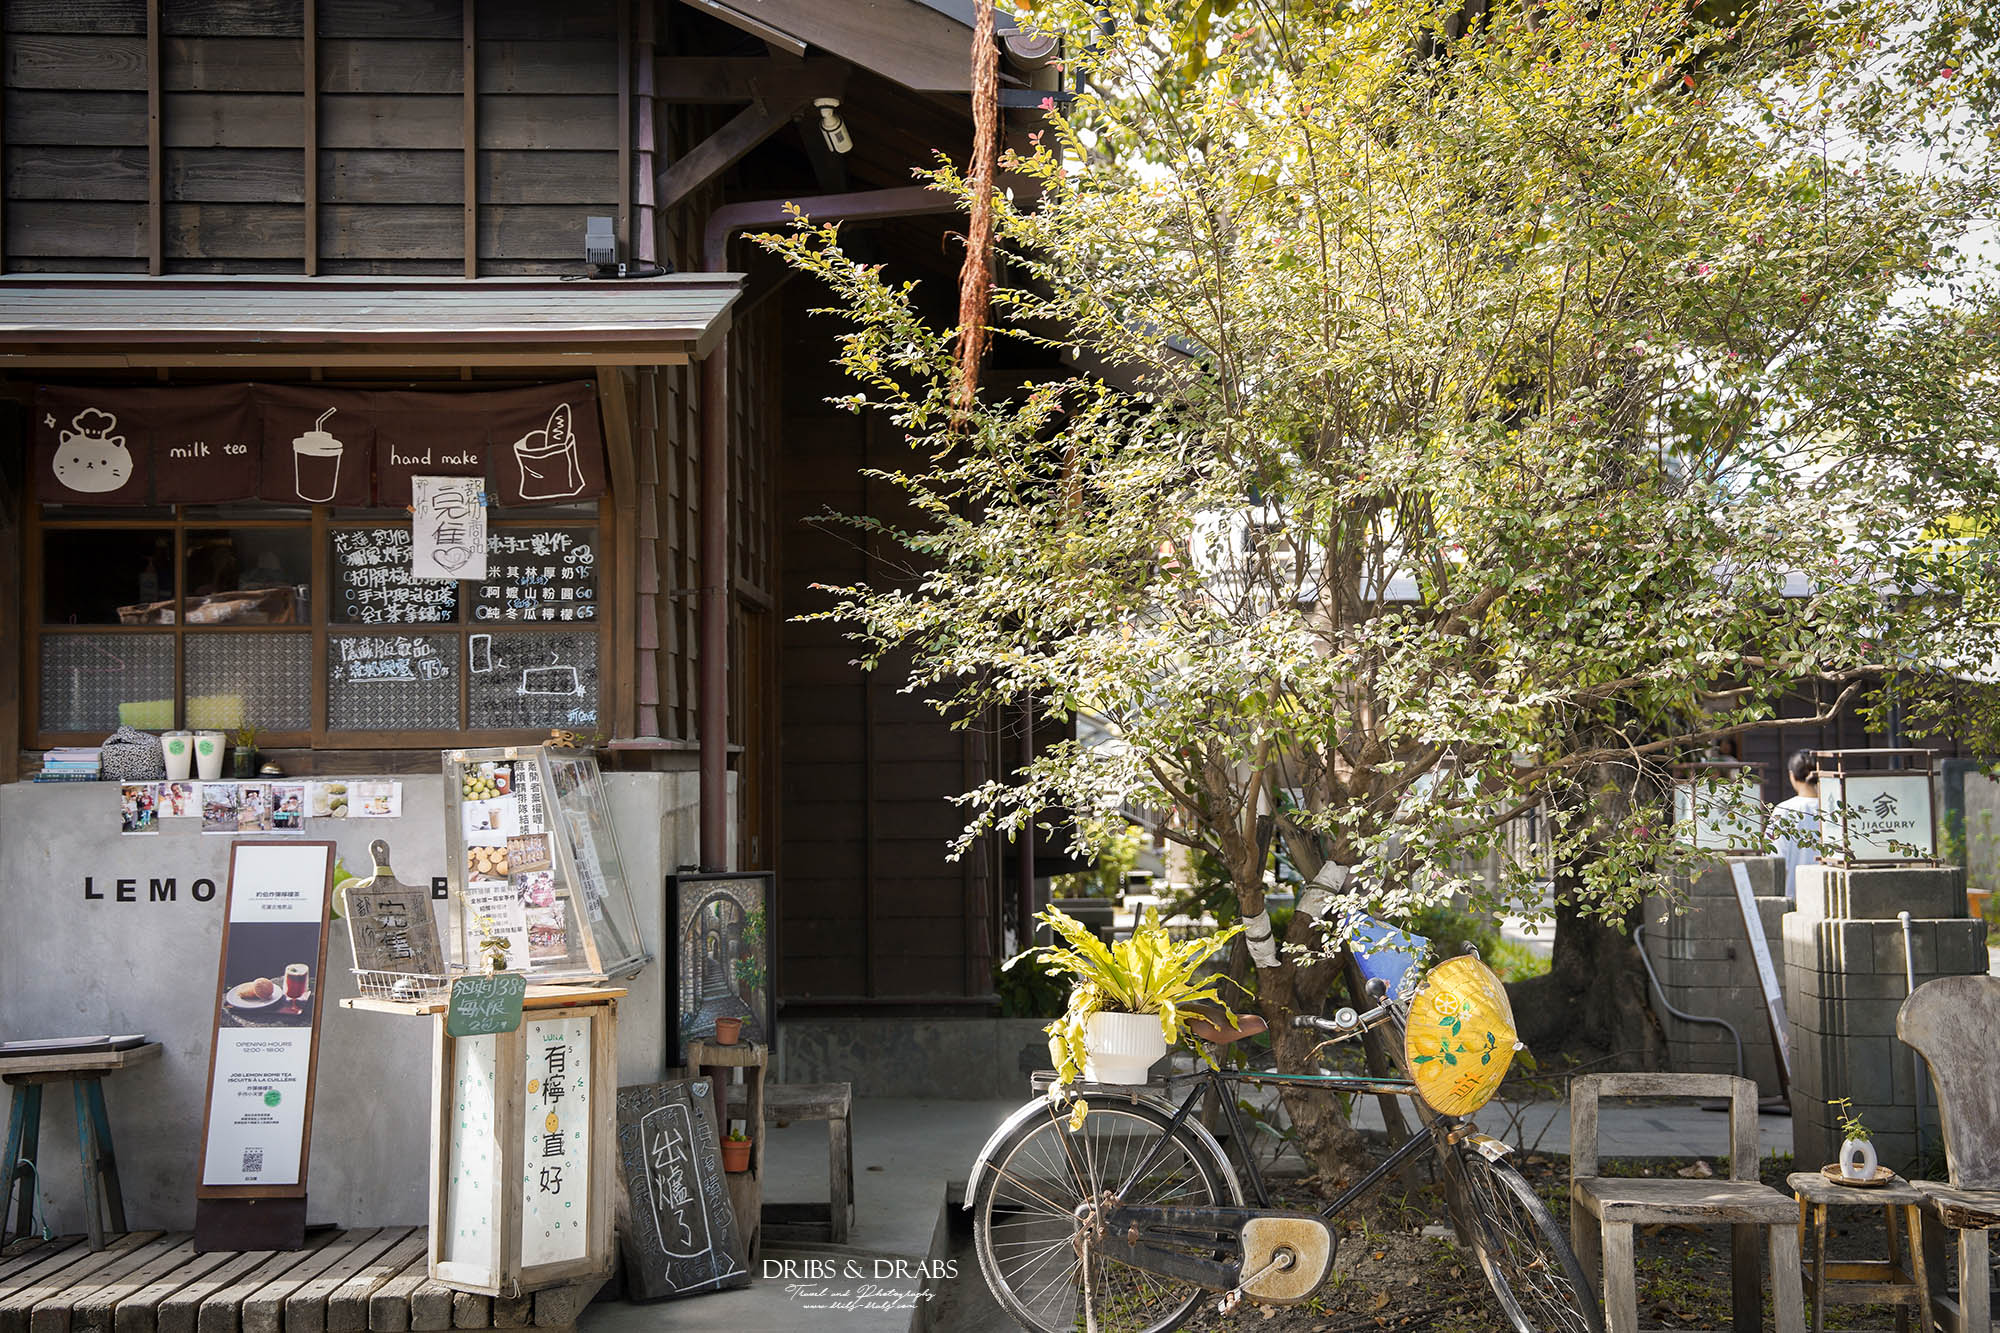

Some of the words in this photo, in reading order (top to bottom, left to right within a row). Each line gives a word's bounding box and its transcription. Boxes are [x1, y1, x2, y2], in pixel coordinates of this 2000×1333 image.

[170, 441, 210, 459] milk
[223, 443, 248, 456] tea
[390, 444, 432, 466] hand
[441, 448, 479, 466] make
[487, 566, 575, 580] 米其林厚奶
[575, 586, 593, 600] 60
[576, 605, 595, 619] 65
[1872, 791, 1898, 819] 家
[1862, 820, 1916, 831] JIACURRY
